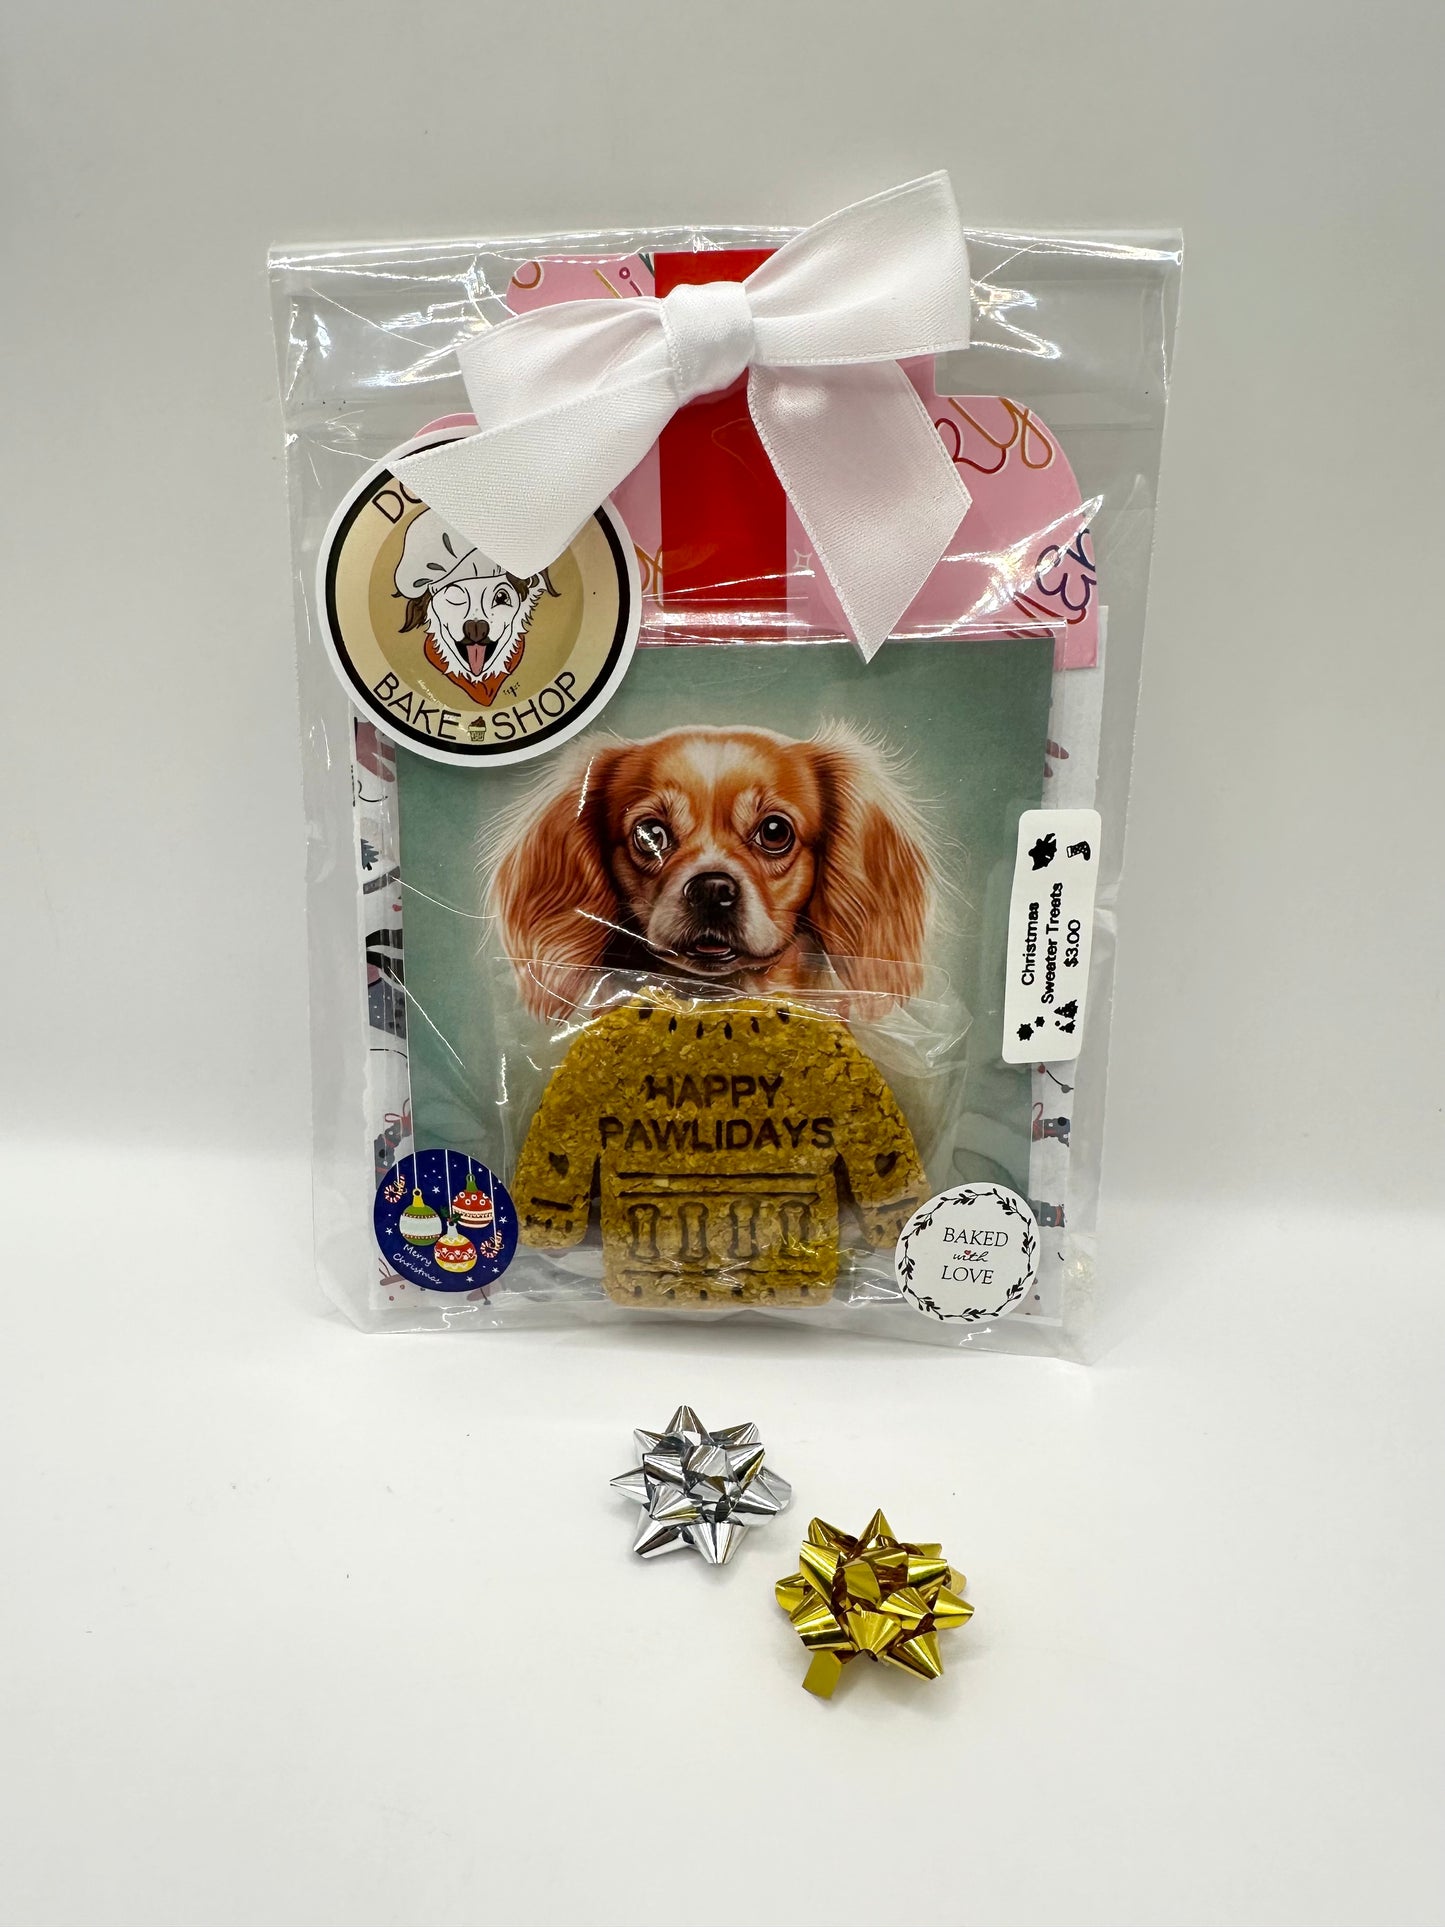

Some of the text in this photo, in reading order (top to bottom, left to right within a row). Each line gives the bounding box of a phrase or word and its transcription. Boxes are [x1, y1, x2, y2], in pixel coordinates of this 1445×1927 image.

[373, 671, 577, 741] BAKE SHOP
[1021, 902, 1040, 985] Christmas
[1041, 882, 1063, 1004] Sweater Treats
[1064, 919, 1081, 968] $3.00
[642, 1073, 784, 1109] HAPPY
[598, 1116, 835, 1152] PAWLIDAYS
[403, 1243, 431, 1267] Merry
[942, 1227, 1009, 1247] BAKED
[392, 1253, 442, 1285] Christmas
[952, 1250, 989, 1263] with
[941, 1265, 994, 1285] LOVE
